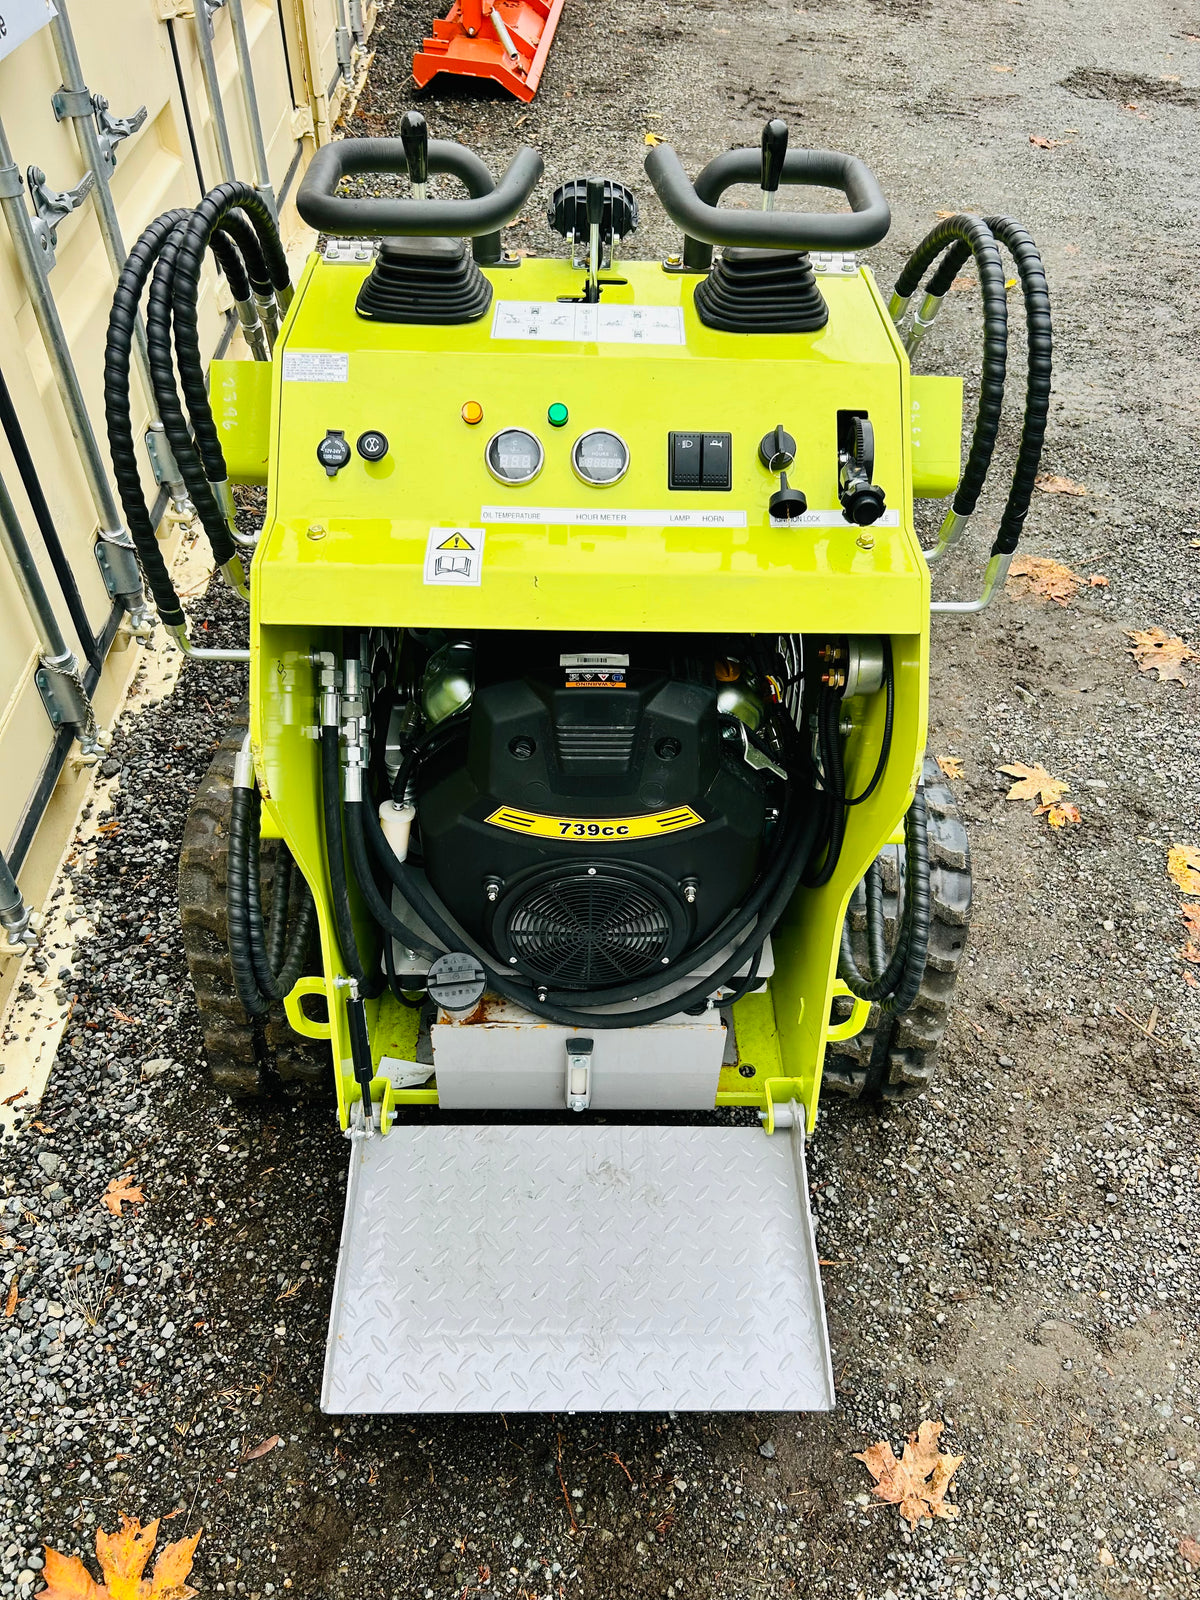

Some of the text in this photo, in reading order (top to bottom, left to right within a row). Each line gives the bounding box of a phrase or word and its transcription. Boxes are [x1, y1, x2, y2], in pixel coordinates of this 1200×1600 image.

[482, 511, 541, 520] OIL TEMPERATURE
[576, 513, 599, 521] HOUR
[669, 514, 690, 522] LAMP
[559, 822, 629, 836] 739cc
